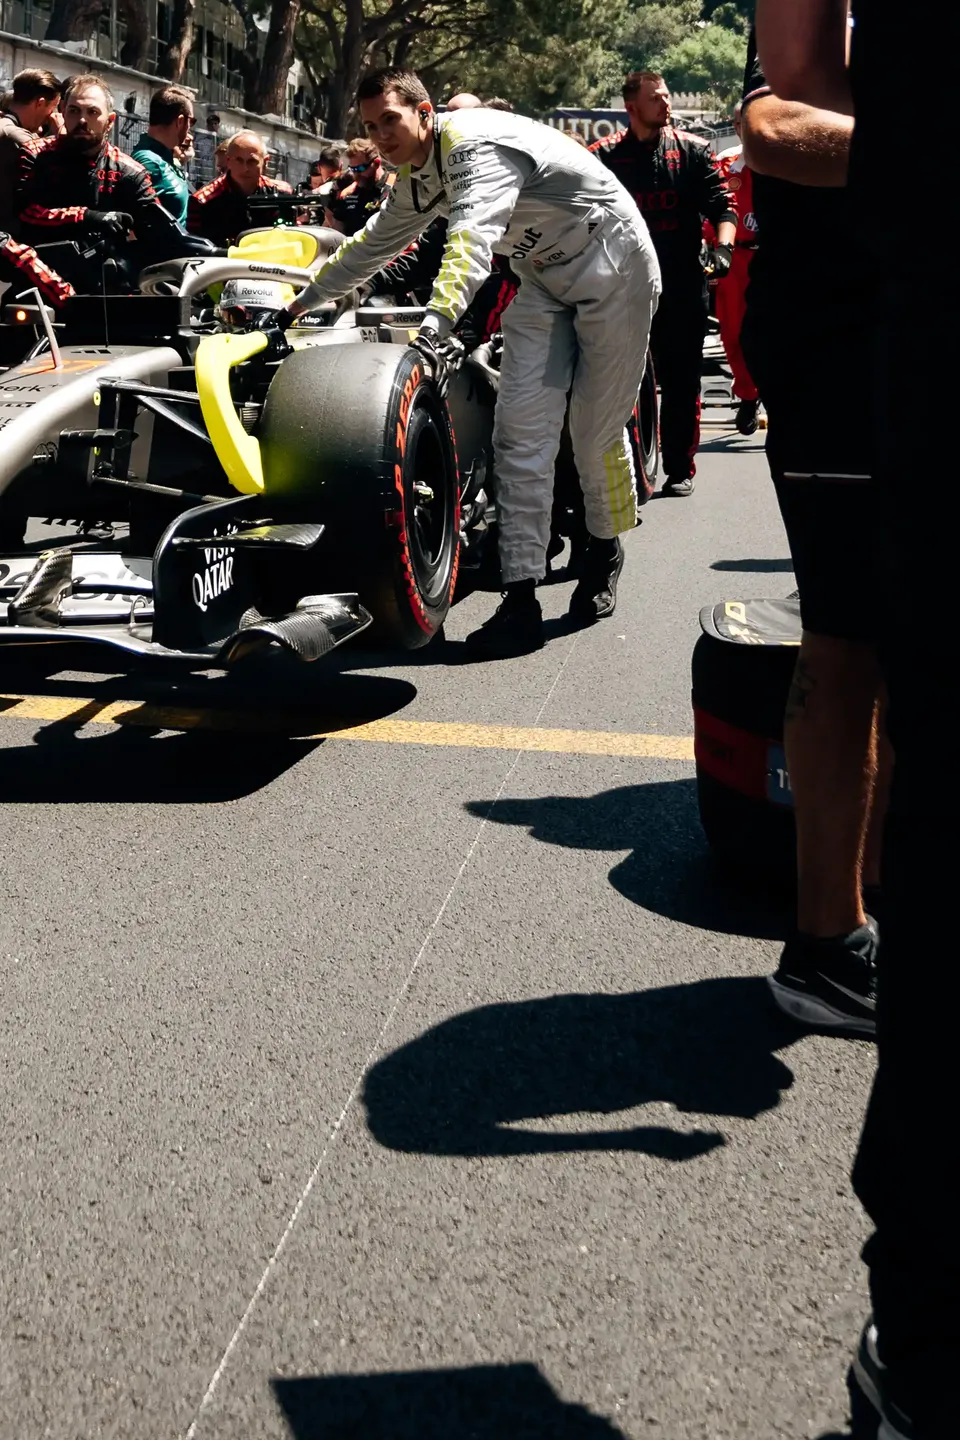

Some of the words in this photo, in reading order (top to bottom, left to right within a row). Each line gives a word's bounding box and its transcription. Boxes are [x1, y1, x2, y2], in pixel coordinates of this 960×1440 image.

[546, 249, 566, 262] YEN
[241, 287, 274, 297] Revolut
[192, 556, 234, 612] QATAR
